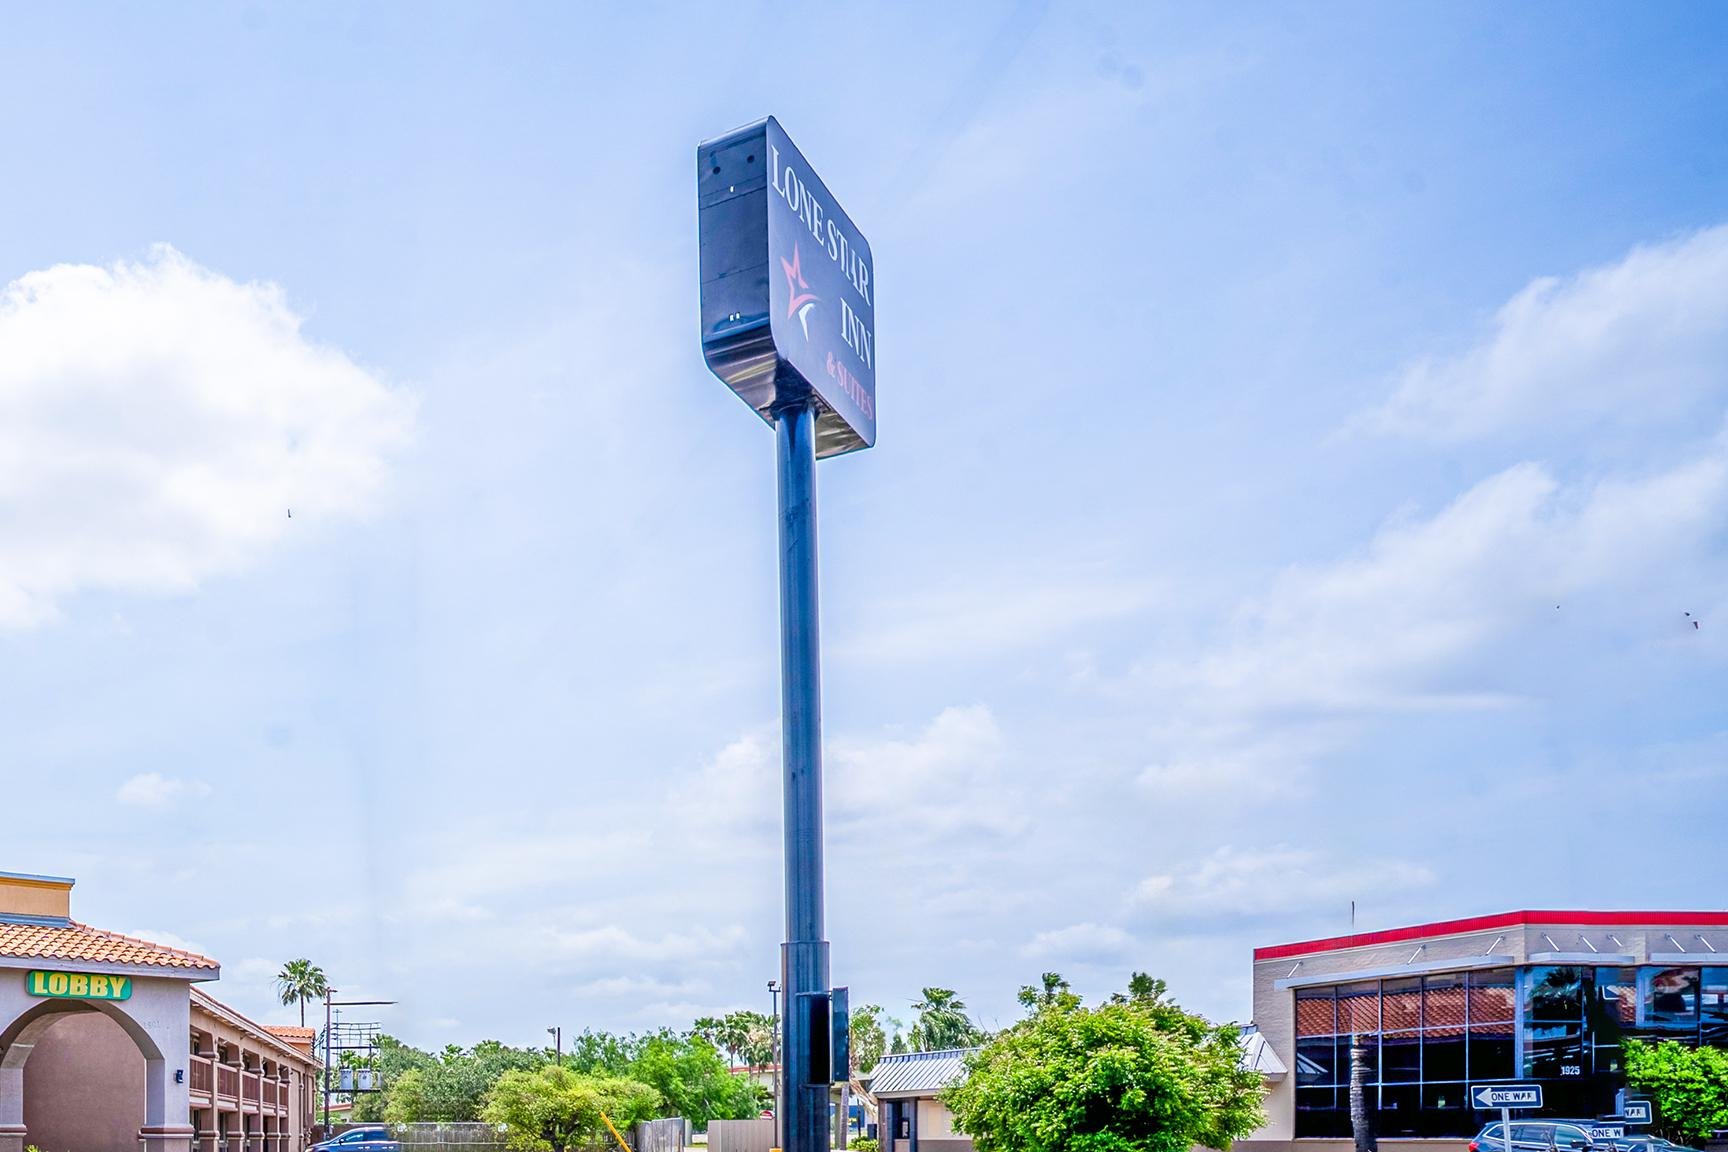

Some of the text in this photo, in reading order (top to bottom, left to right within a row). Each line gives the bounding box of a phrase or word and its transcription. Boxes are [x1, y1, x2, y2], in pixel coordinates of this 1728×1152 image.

[771, 144, 872, 306] LONE STAR
[840, 297, 872, 370] INN
[826, 351, 873, 420] & SUITES
[34, 971, 128, 998] LOBBY
[1560, 1065, 1580, 1076] 1925
[1491, 1092, 1511, 1101] ONE
[1592, 1129, 1611, 1138] ONE
